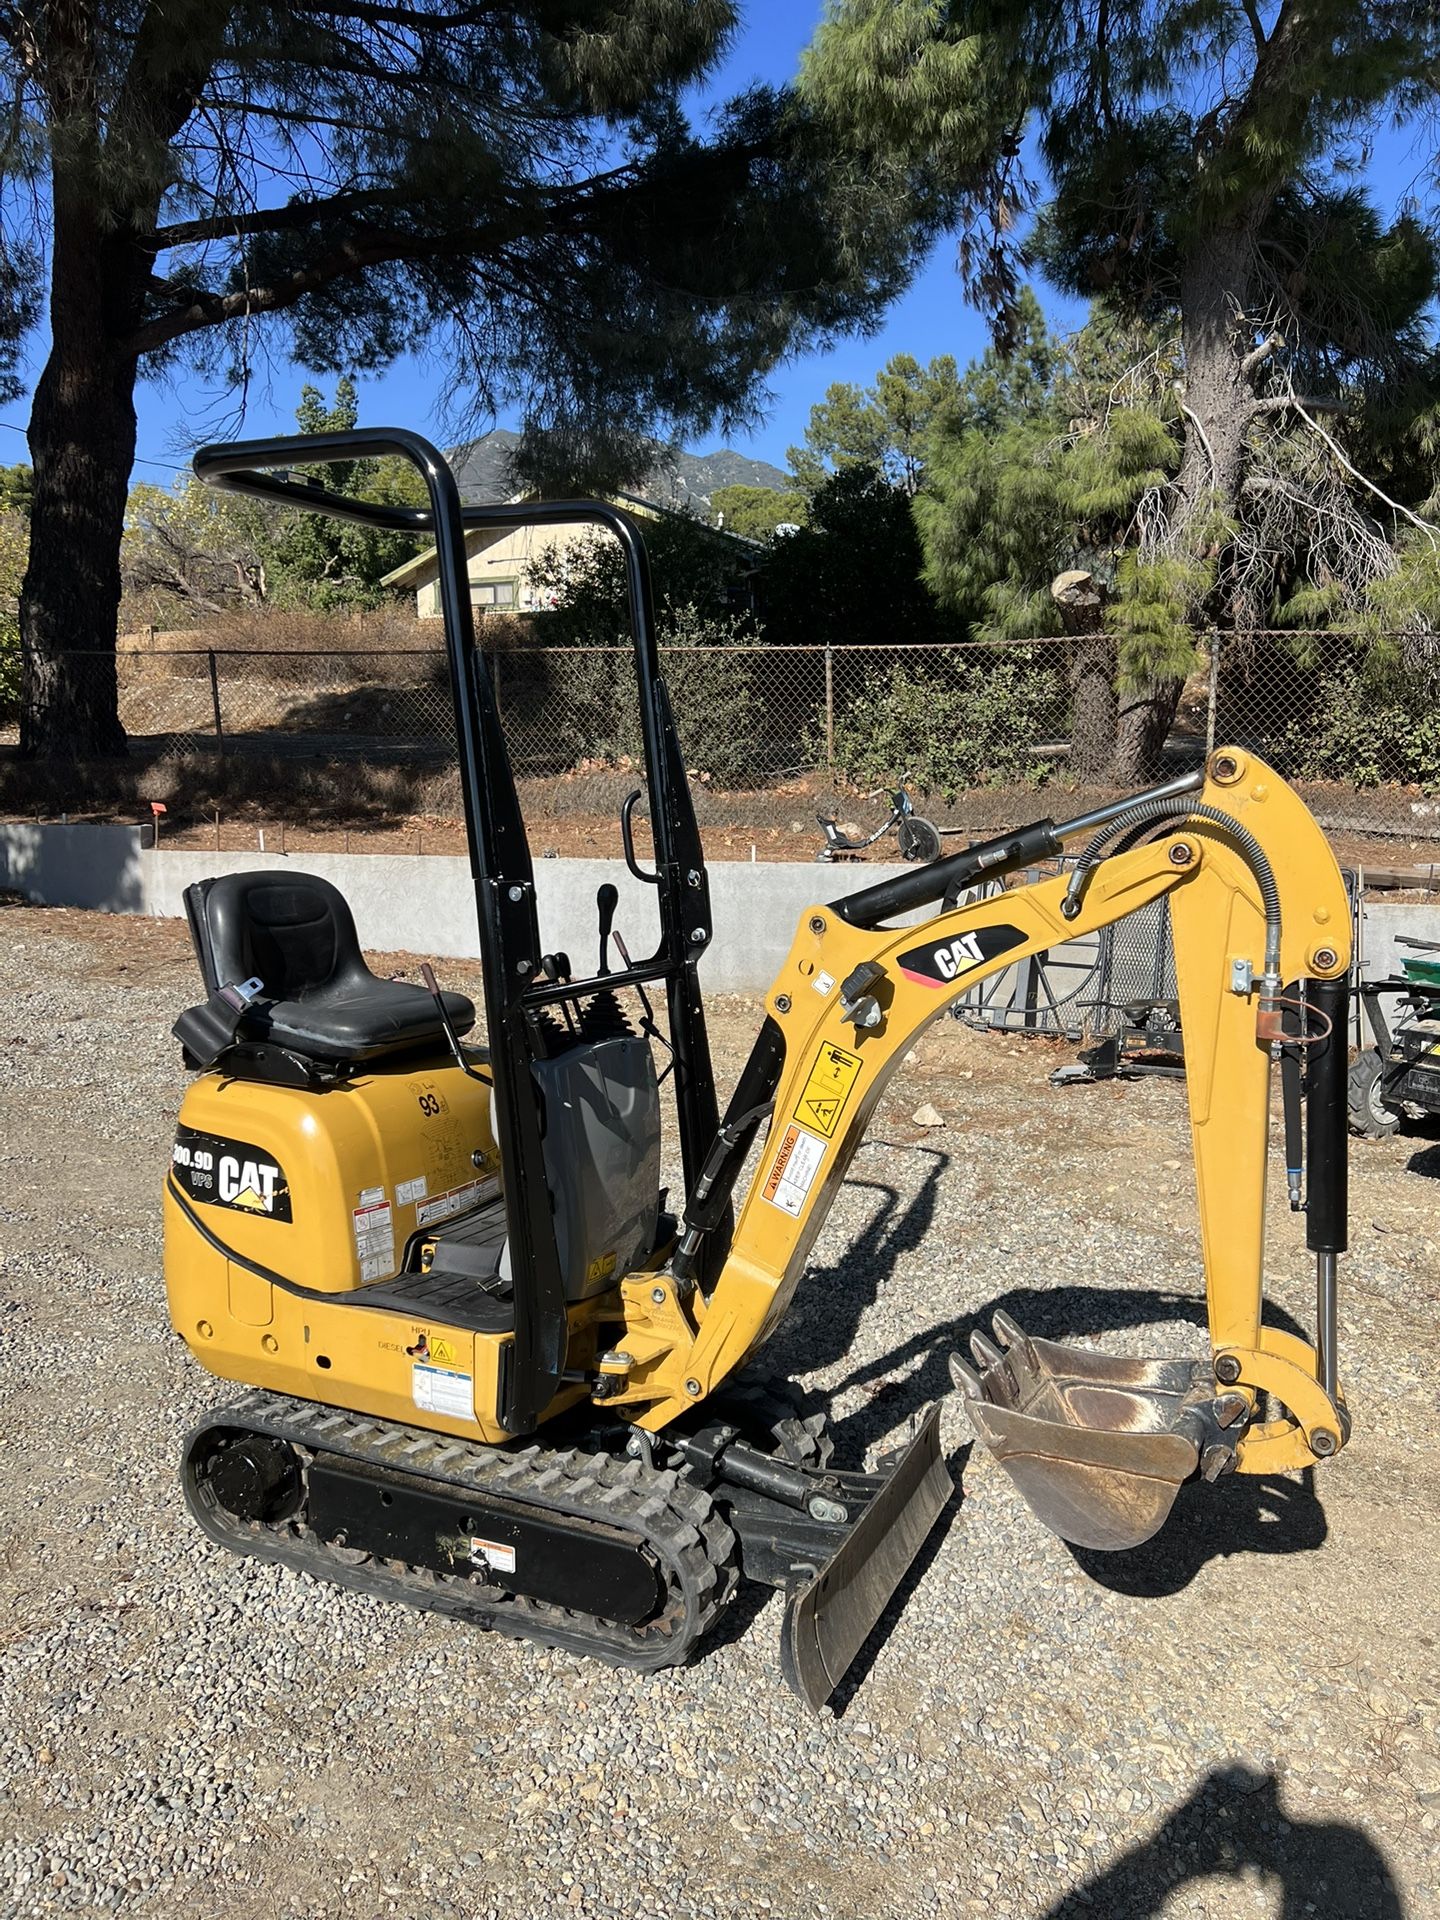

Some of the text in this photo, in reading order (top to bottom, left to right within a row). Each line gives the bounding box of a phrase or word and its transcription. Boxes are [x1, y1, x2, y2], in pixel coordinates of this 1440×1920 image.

[934, 931, 985, 978] CAT
[418, 1093, 440, 1117] 93
[191, 1171, 213, 1189] VPS
[772, 1136, 795, 1181] WARNING
[218, 1155, 279, 1213] CAT
